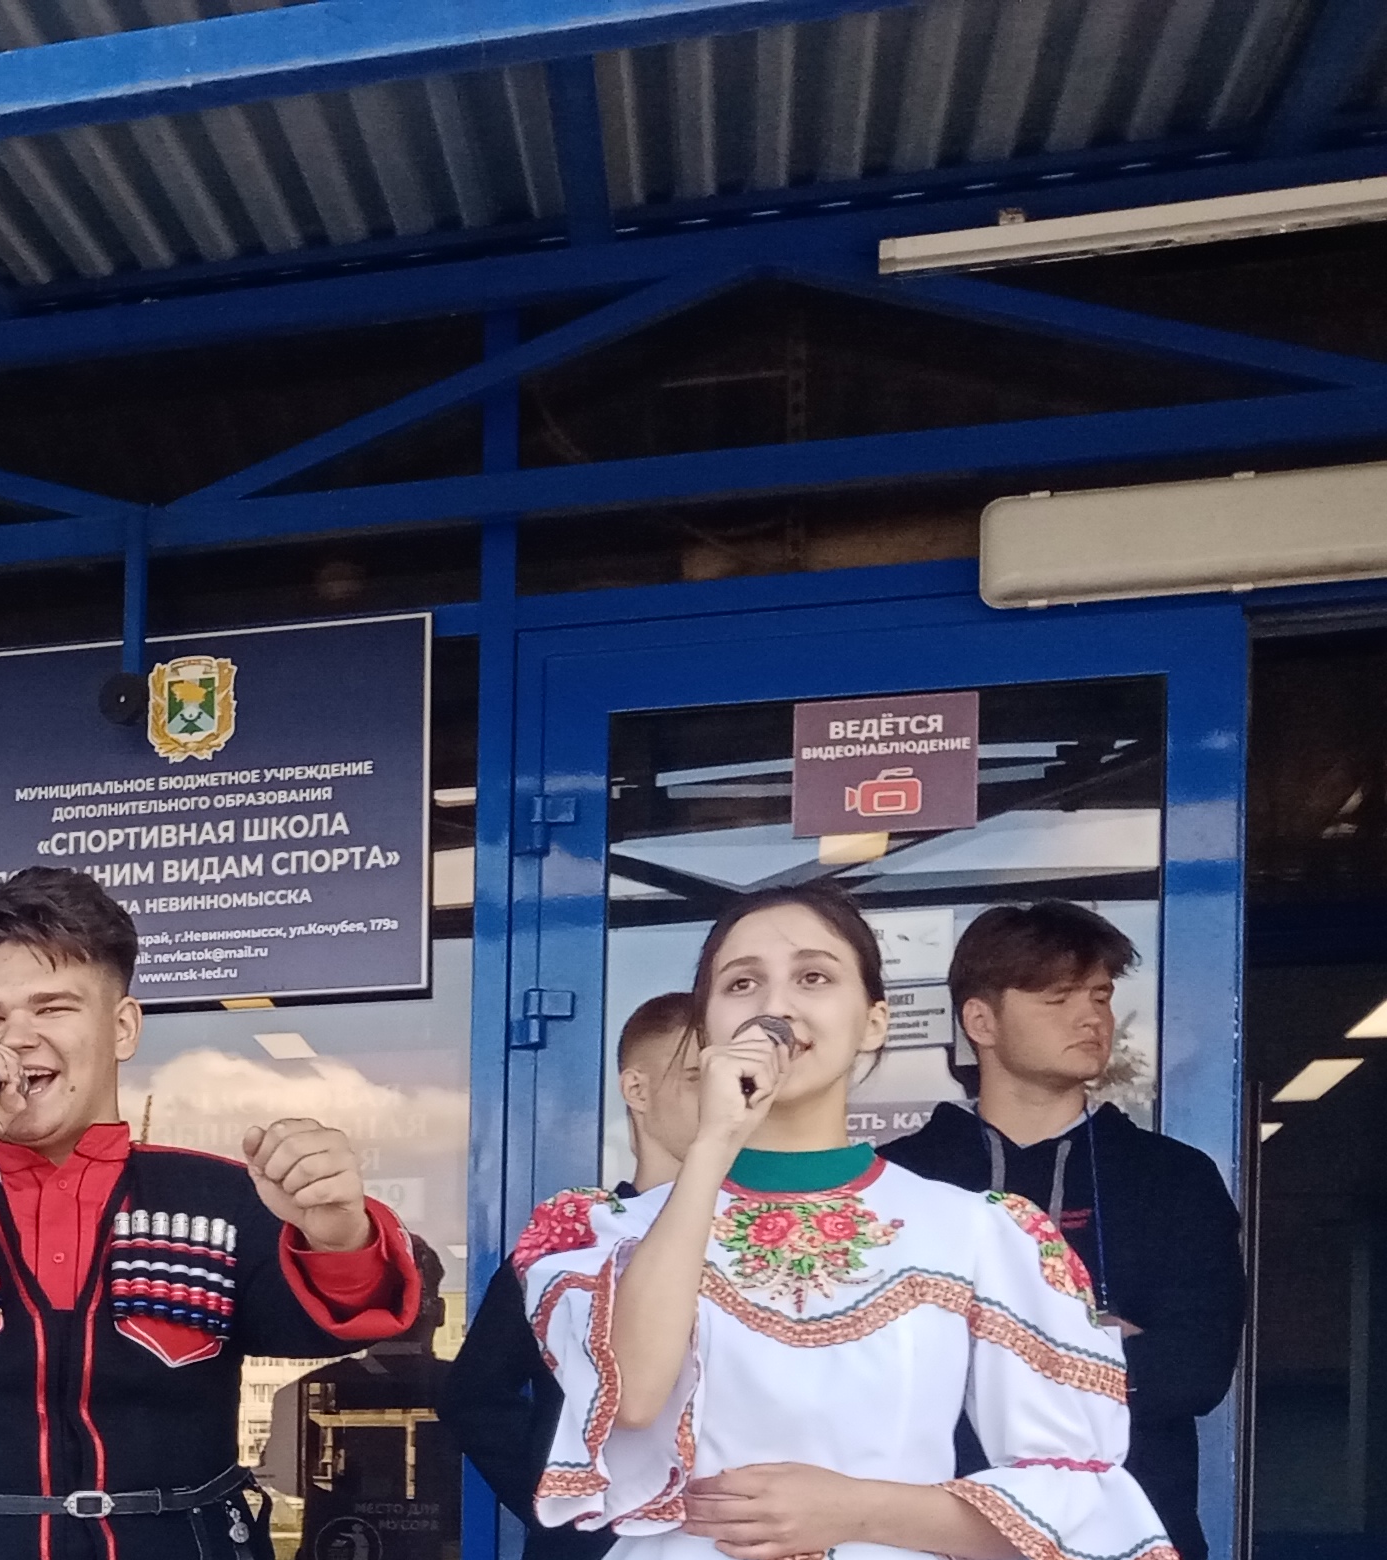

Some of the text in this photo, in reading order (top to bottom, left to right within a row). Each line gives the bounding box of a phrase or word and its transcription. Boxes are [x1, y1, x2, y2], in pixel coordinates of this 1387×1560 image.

[829, 712, 944, 741] ВЕДЁТСЯ
[801, 737, 972, 761] ВИДЕОНАБЛЮДЕНИЕ
[15, 759, 374, 802] МУНИЦИПАЛЬНОЕ БЮДЖЕТНОЕ УЧРЕЖДЕНИЕ
[51, 786, 333, 823] ДОПОЛНИТЕЛЬНОГО ОБРАЗОВАНИЯ
[36, 811, 351, 856] «СПОРТИВНАЯ ШКОЛА
[162, 854, 265, 885] ВИДАМ
[271, 845, 401, 875] СПОРТА»
[144, 888, 313, 914] НЕВИННОМЫССКА
[174, 926, 287, 944] г.Невинномысск,
[289, 919, 368, 940] ул.Кочубея,
[369, 918, 400, 932] 179а
[153, 946, 269, 965] nevkatok@mail.ru
[138, 966, 239, 984] www.nsk-led.ru
